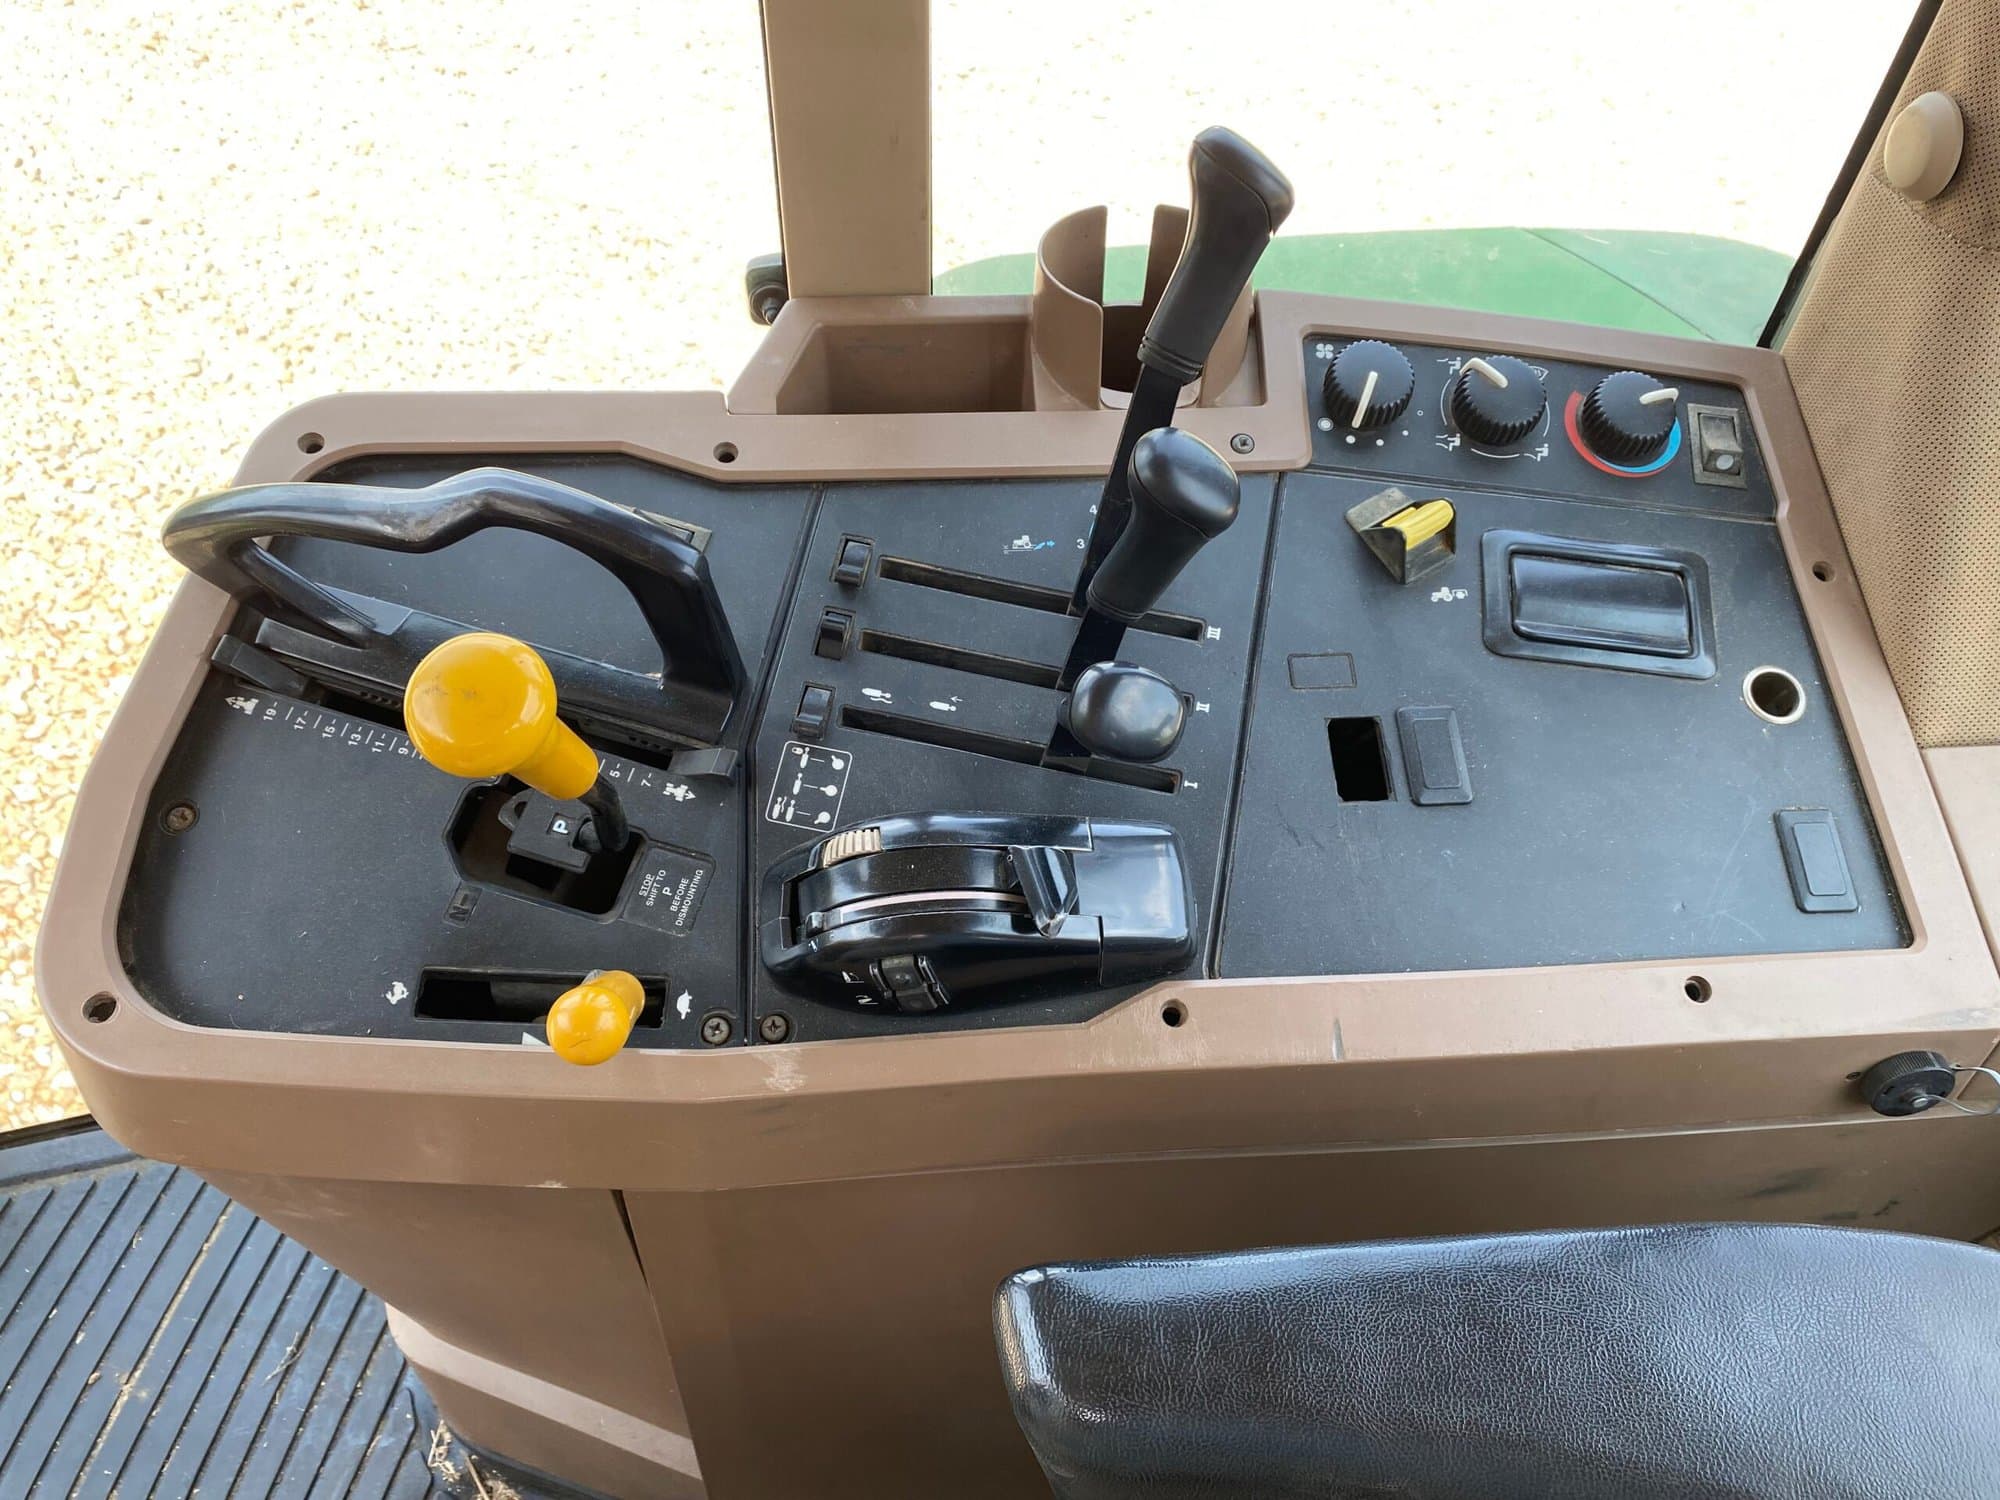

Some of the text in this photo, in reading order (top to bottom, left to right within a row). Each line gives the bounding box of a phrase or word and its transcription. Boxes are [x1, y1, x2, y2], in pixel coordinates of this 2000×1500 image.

[1089, 504, 1098, 515] 4
[1077, 538, 1085, 549] 3
[1207, 625, 1221, 640] III
[1196, 701, 1210, 713] II
[263, 708, 277, 721] 19
[293, 717, 307, 730] 17
[348, 734, 362, 746] 13
[372, 742, 385, 753] 11
[398, 746, 409, 755] 9
[609, 769, 620, 778] 5
[641, 779, 651, 787] 7
[552, 820, 568, 834] P
[639, 873, 655, 896] STOP
[646, 870, 666, 906] SHIFT TO
[662, 887, 672, 896] P
[670, 878, 689, 912] BEFORE
[675, 869, 704, 926] DISMOUNTING
